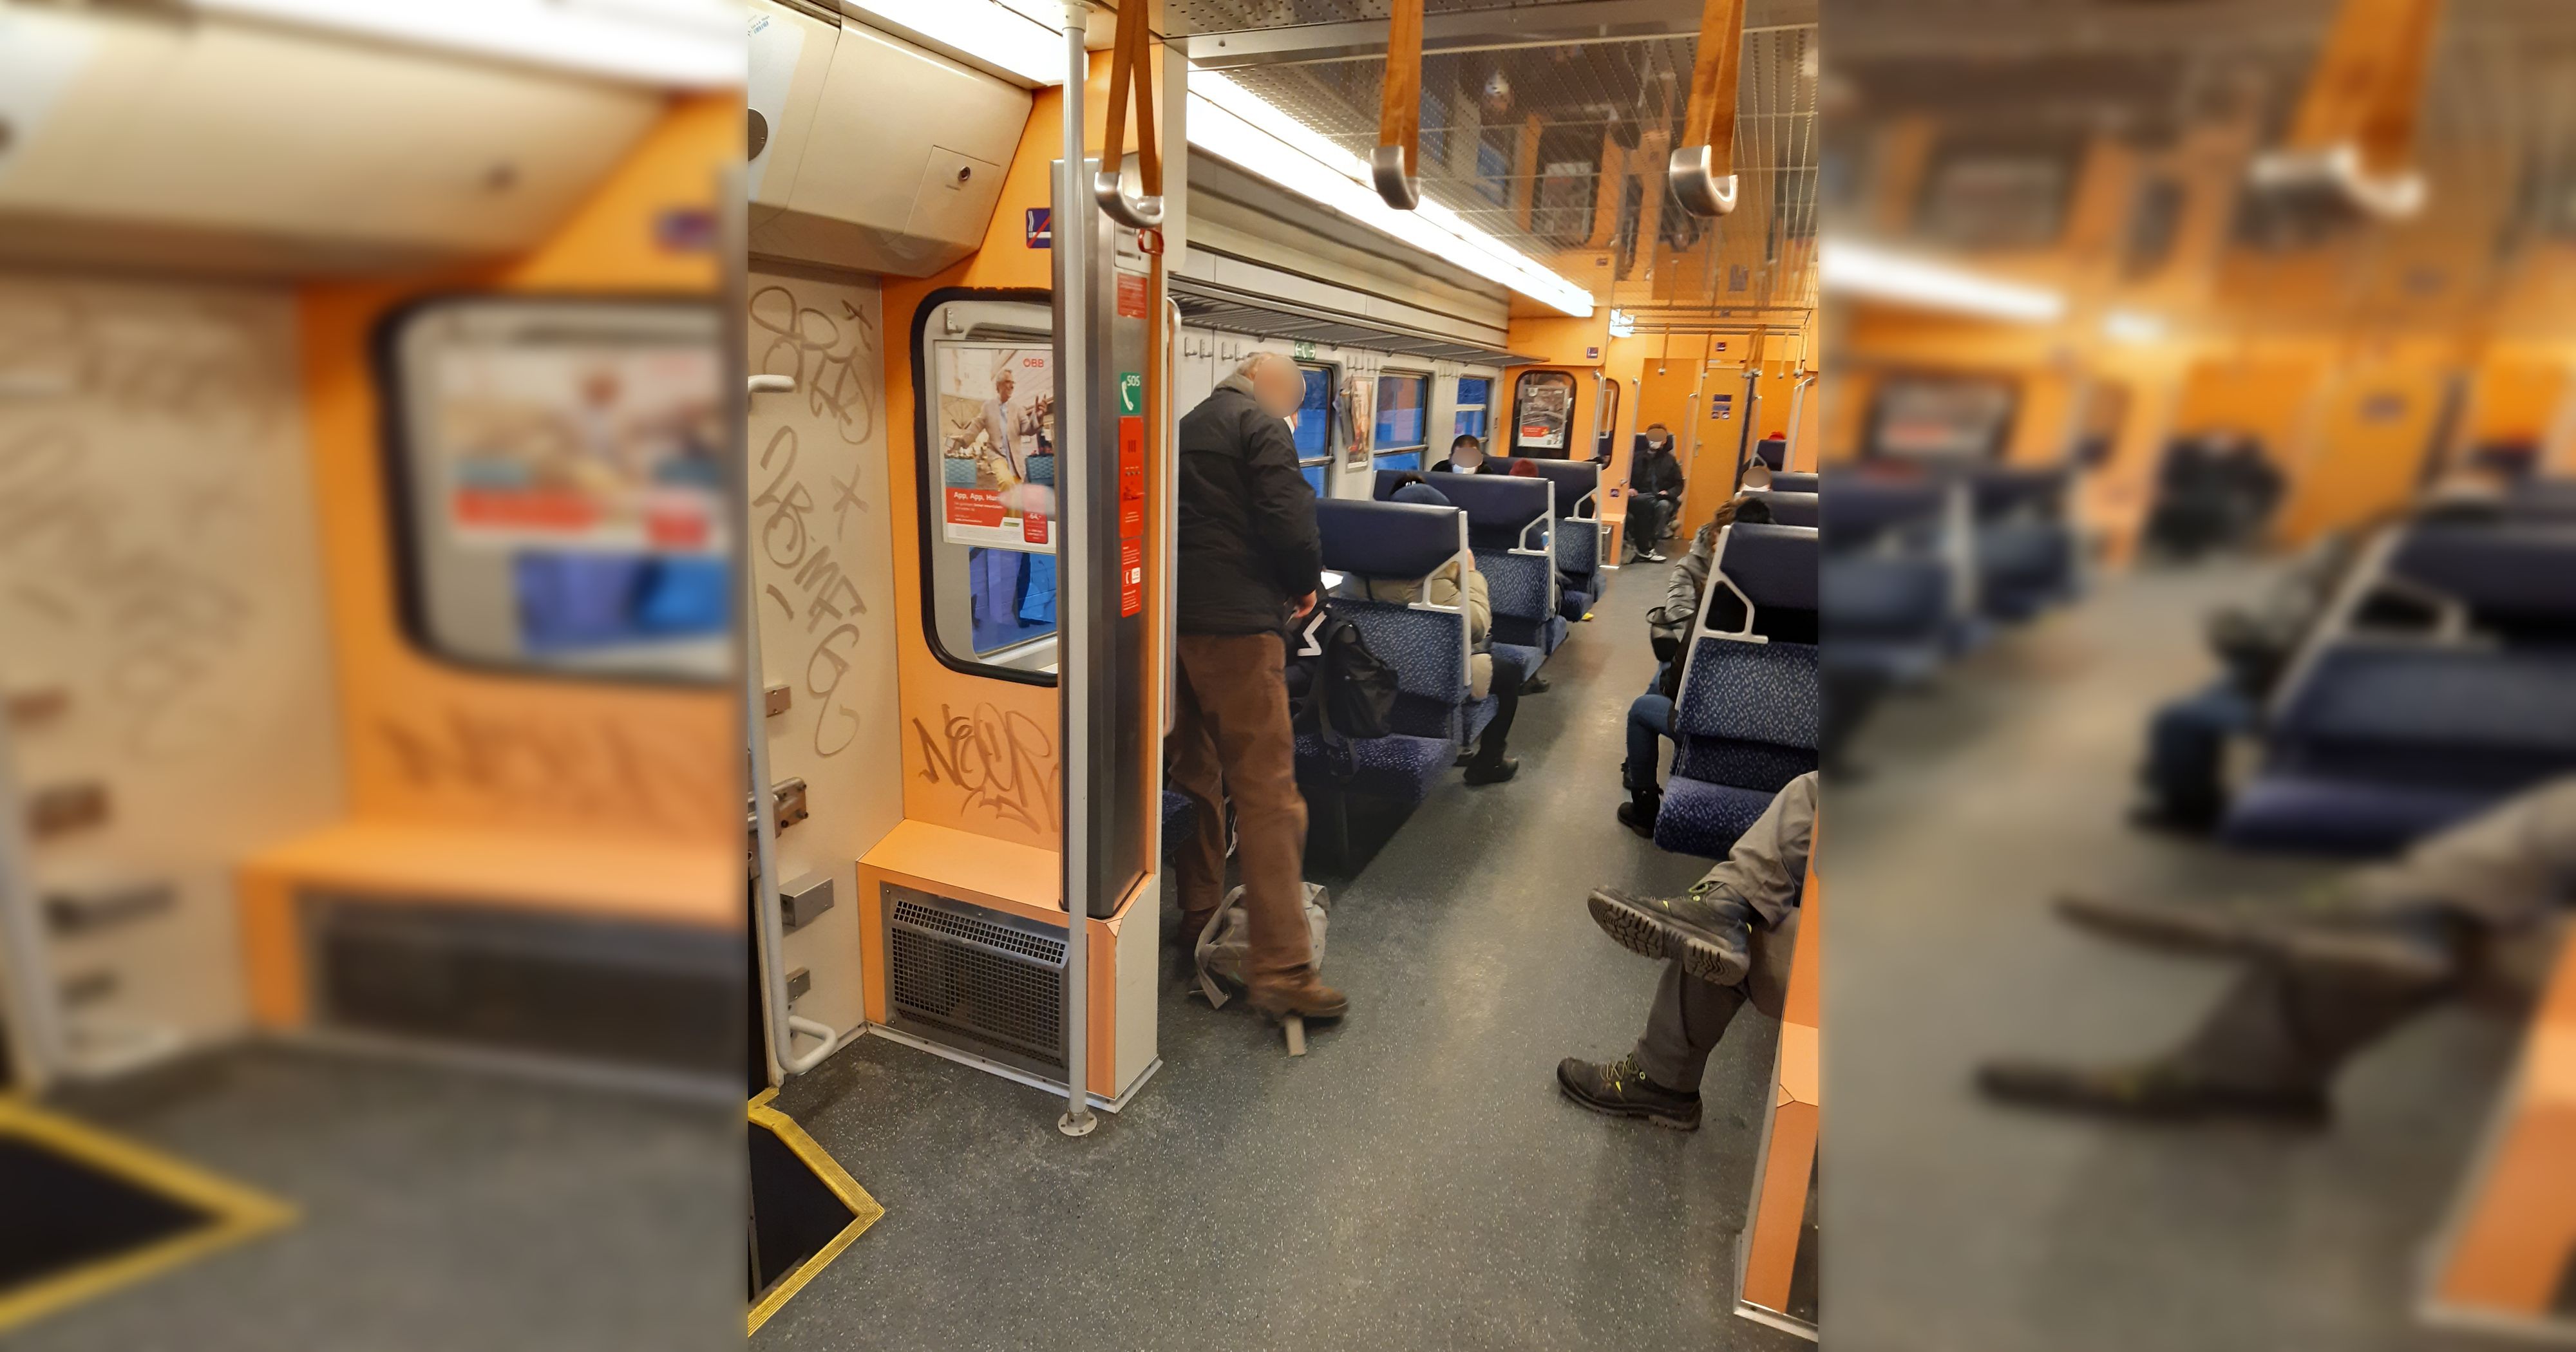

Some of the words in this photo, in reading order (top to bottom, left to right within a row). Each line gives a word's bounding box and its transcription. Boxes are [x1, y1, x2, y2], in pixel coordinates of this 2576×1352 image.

[1127, 375, 1141, 386] SOS
[954, 491, 968, 500] App.
[970, 493, 985, 502] App.
